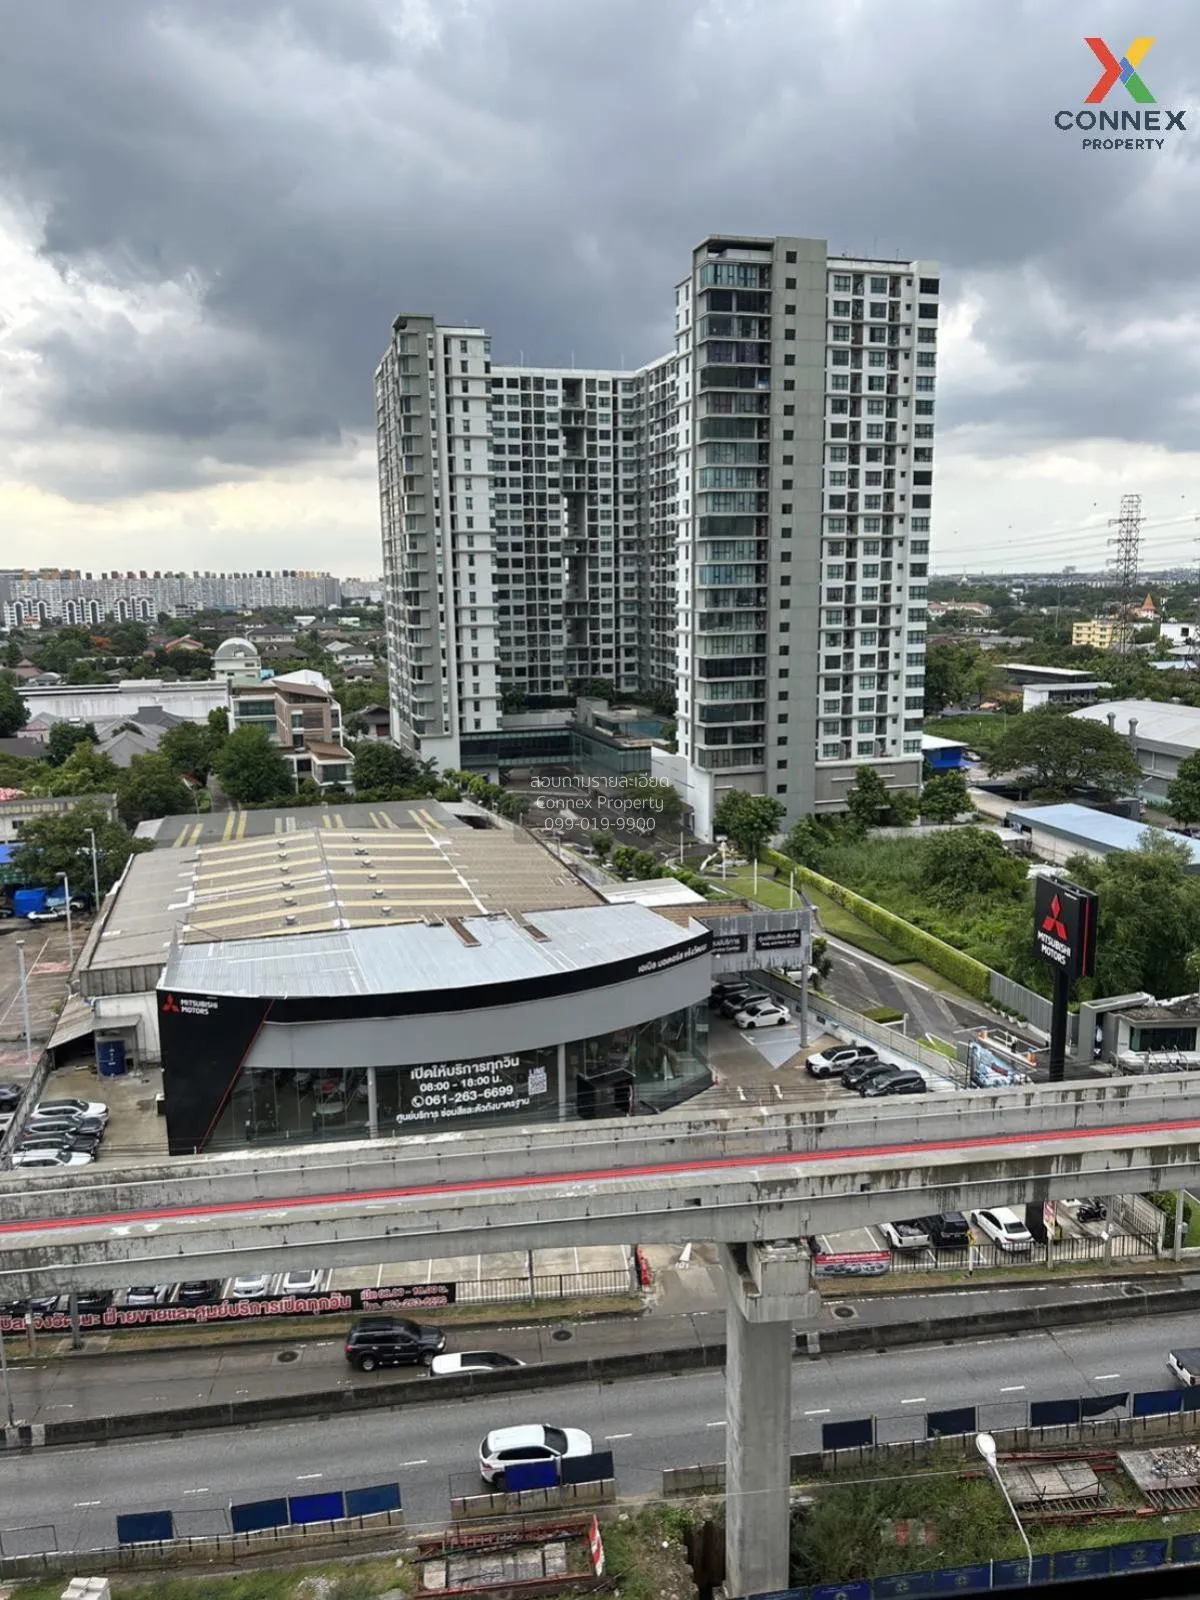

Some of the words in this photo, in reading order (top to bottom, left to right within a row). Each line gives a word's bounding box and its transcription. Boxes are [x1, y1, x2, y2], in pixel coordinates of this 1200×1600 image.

[1037, 930, 1071, 957] MITSUBISHI
[1041, 943, 1067, 966] MOTORS
[180, 998, 219, 1009] MITSUBISHI
[181, 1006, 209, 1015] MOTORS
[410, 1056, 520, 1080] เปิดให้บริการทุกวัน
[420, 1081, 450, 1092] 08:00
[461, 1075, 490, 1088] 18:00
[425, 1085, 514, 1106] 061-263-6699
